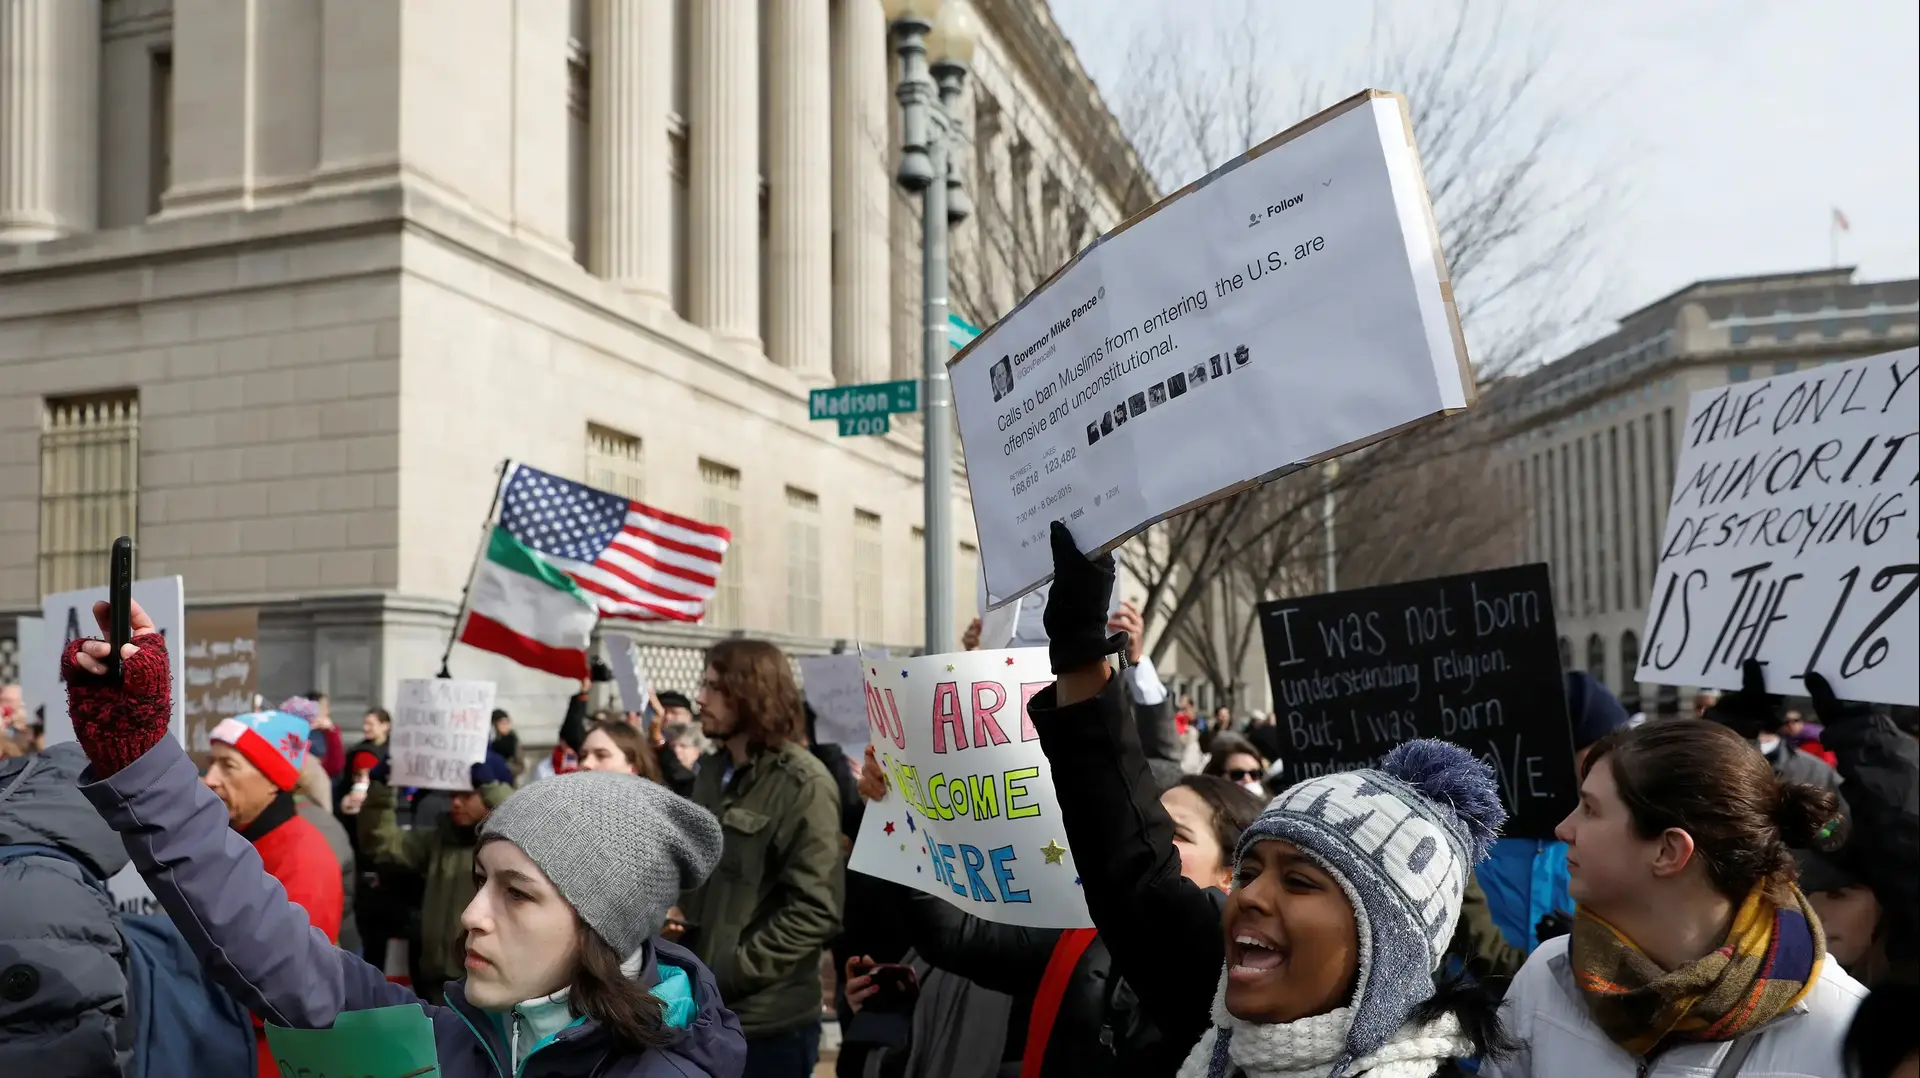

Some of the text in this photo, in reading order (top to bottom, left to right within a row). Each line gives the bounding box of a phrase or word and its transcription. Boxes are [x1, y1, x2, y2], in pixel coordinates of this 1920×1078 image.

[1266, 192, 1304, 218] Follow
[997, 236, 1325, 432] Calls to ban Muslims from entering the U.S. are
[1013, 295, 1097, 366] Governor Mike Pence
[813, 390, 889, 416] Madison
[845, 416, 885, 435] 700
[1003, 334, 1178, 456] offensive and unconstitutional.
[1691, 360, 1919, 448] THE ONLY
[1009, 445, 1057, 483] RETWEETS LIKES
[1011, 446, 1077, 497] 168,618 123,482
[1673, 432, 1919, 508] MINORIT
[1028, 505, 1037, 517] AM
[1041, 500, 1046, 510] 8
[1046, 494, 1058, 507] Dec
[1057, 484, 1073, 500] 2015
[1661, 492, 1907, 564] DESTROYING
[1271, 581, 1540, 667] I was not born
[1641, 568, 1709, 671] IS
[1701, 561, 1804, 677] THE
[1281, 649, 1512, 708] understanding religion.
[865, 681, 906, 750] OU
[933, 680, 1057, 754] ARE
[1288, 694, 1503, 751] But, I was born
[882, 753, 1042, 821] WELCOME
[922, 828, 1032, 904] HERE
